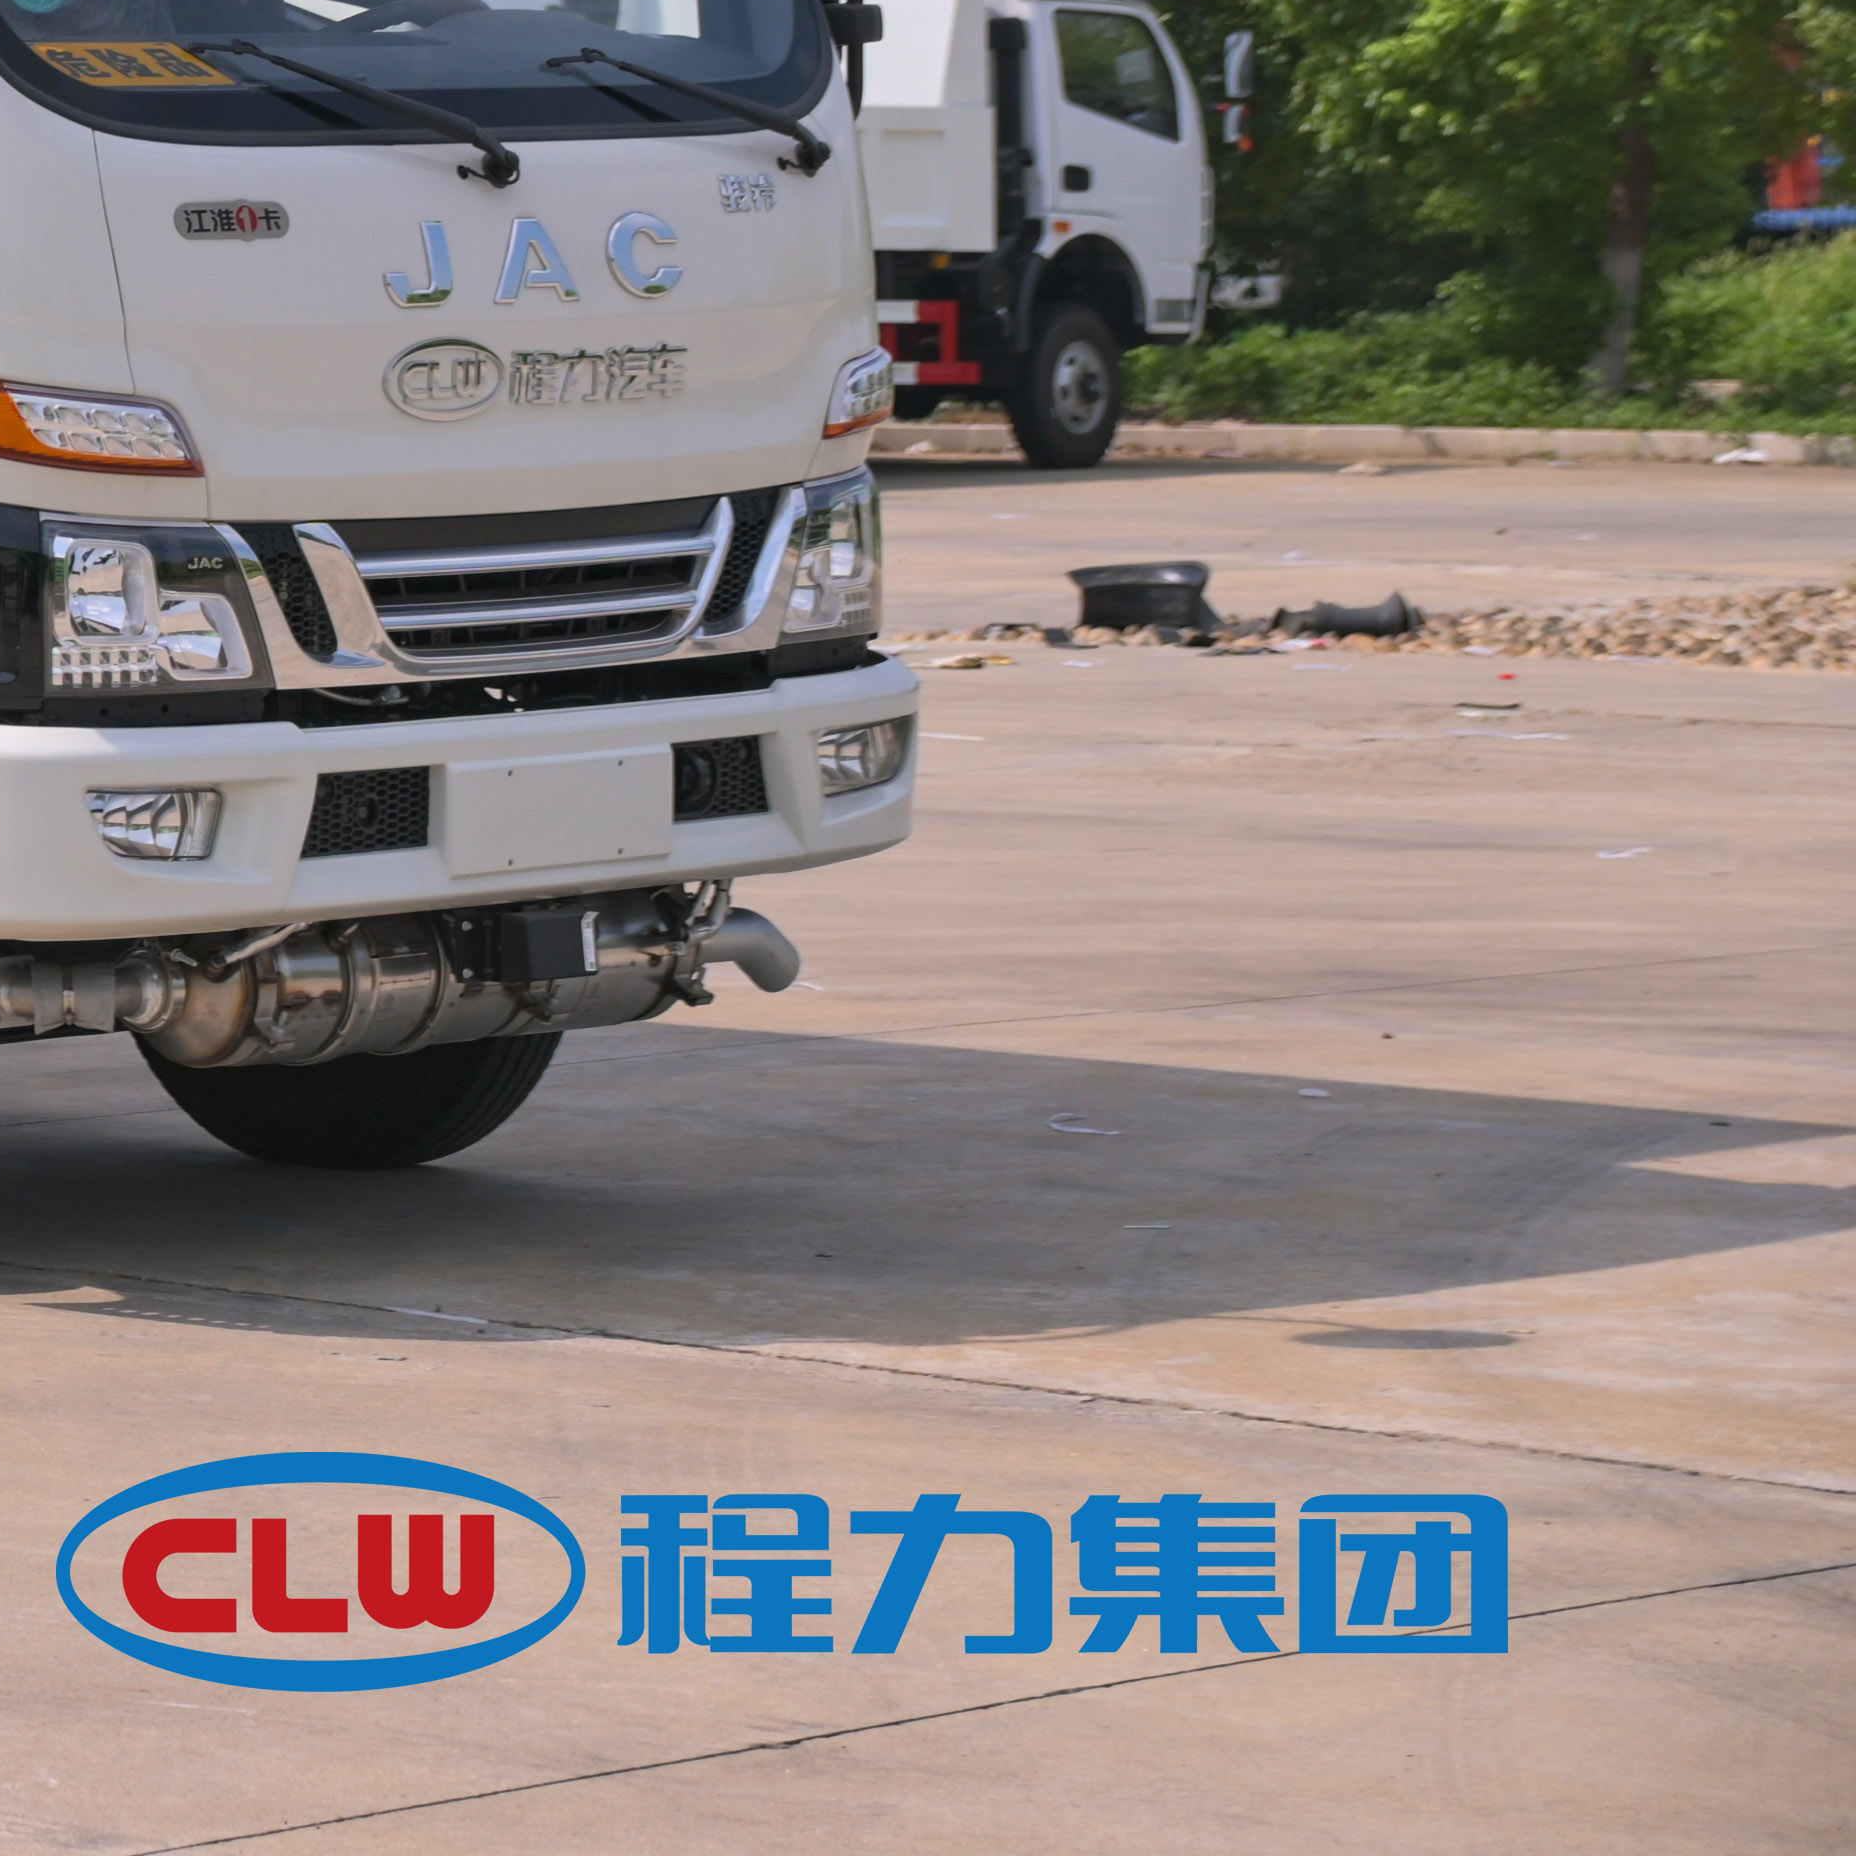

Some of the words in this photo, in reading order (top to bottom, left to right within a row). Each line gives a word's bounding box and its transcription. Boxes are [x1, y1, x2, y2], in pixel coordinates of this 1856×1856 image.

[45, 47, 215, 79] 危险品
[383, 210, 684, 308] JAC
[397, 356, 487, 403] CLW
[508, 342, 688, 405] 程力汽车
[187, 556, 225, 570] JAC
